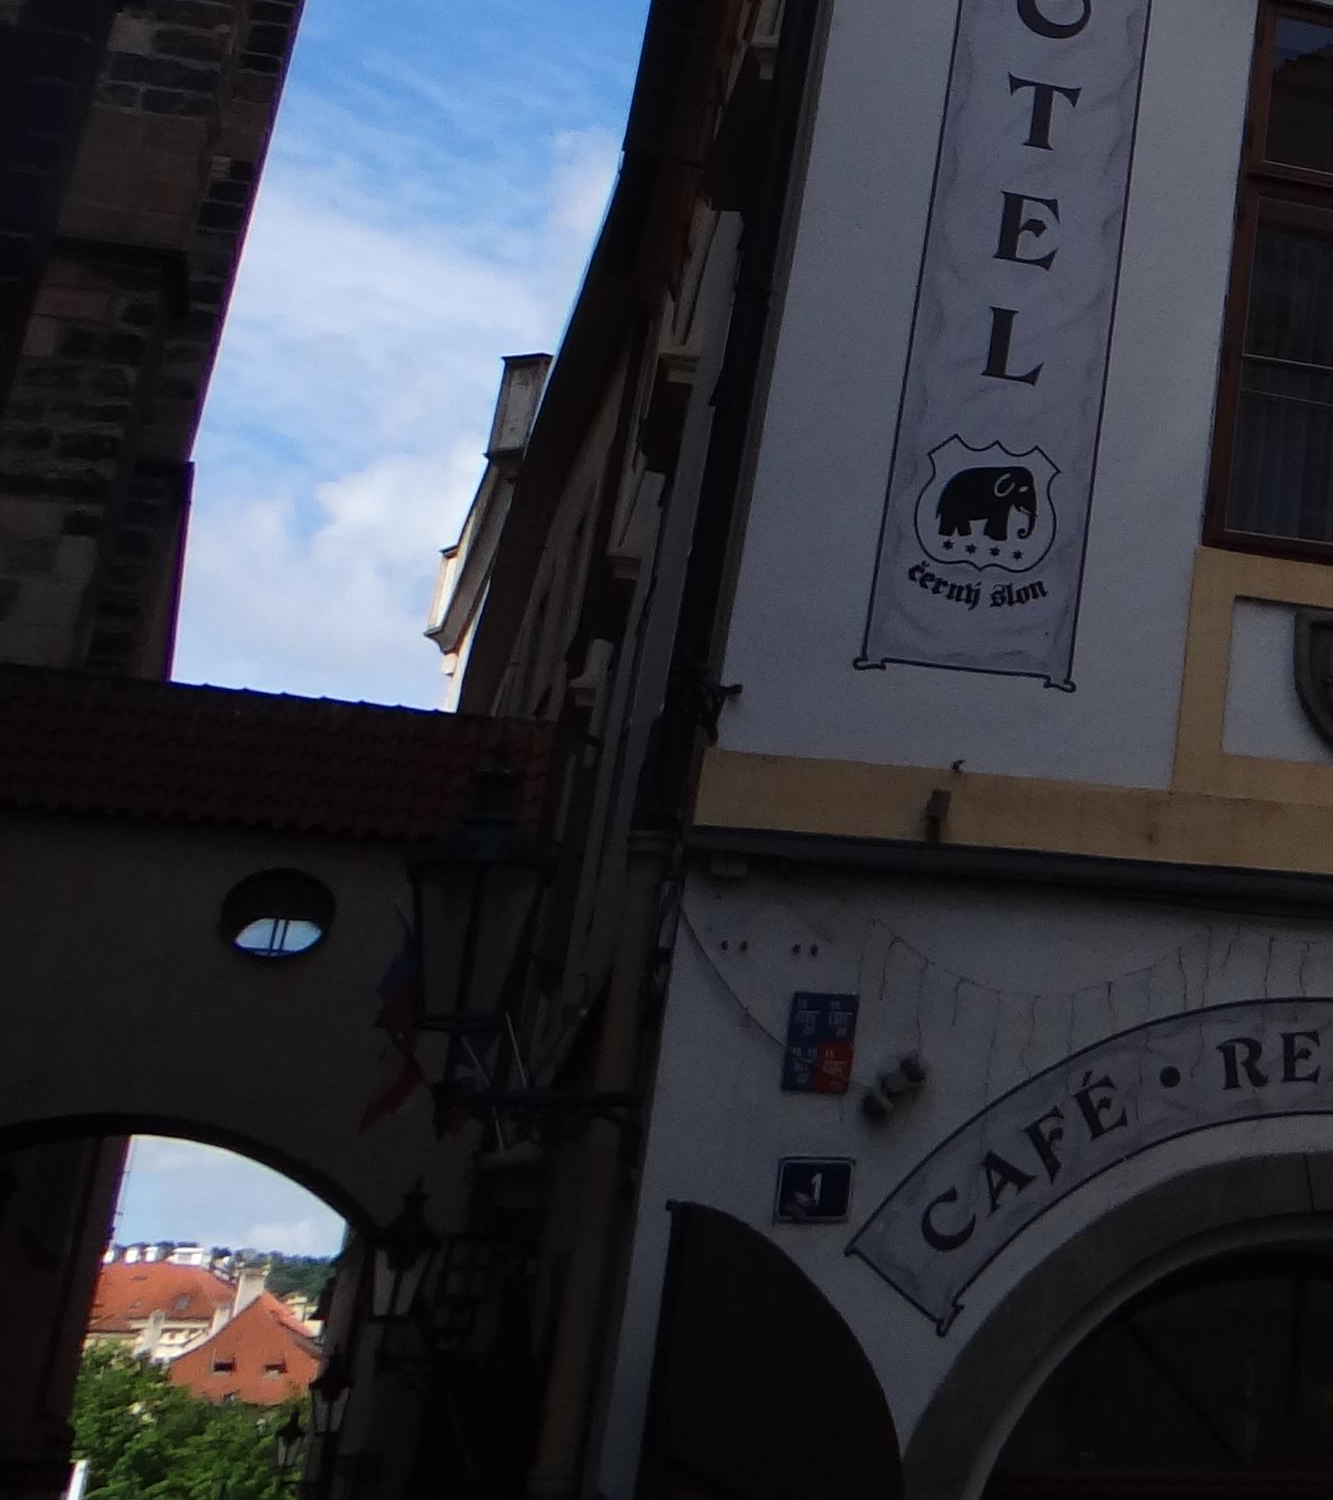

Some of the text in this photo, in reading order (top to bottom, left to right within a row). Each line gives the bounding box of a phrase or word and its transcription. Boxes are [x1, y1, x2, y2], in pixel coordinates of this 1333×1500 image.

[989, 580, 1049, 607] slon
[920, 1071, 1129, 1253] CAFÉ
[811, 1172, 824, 1207] 1
